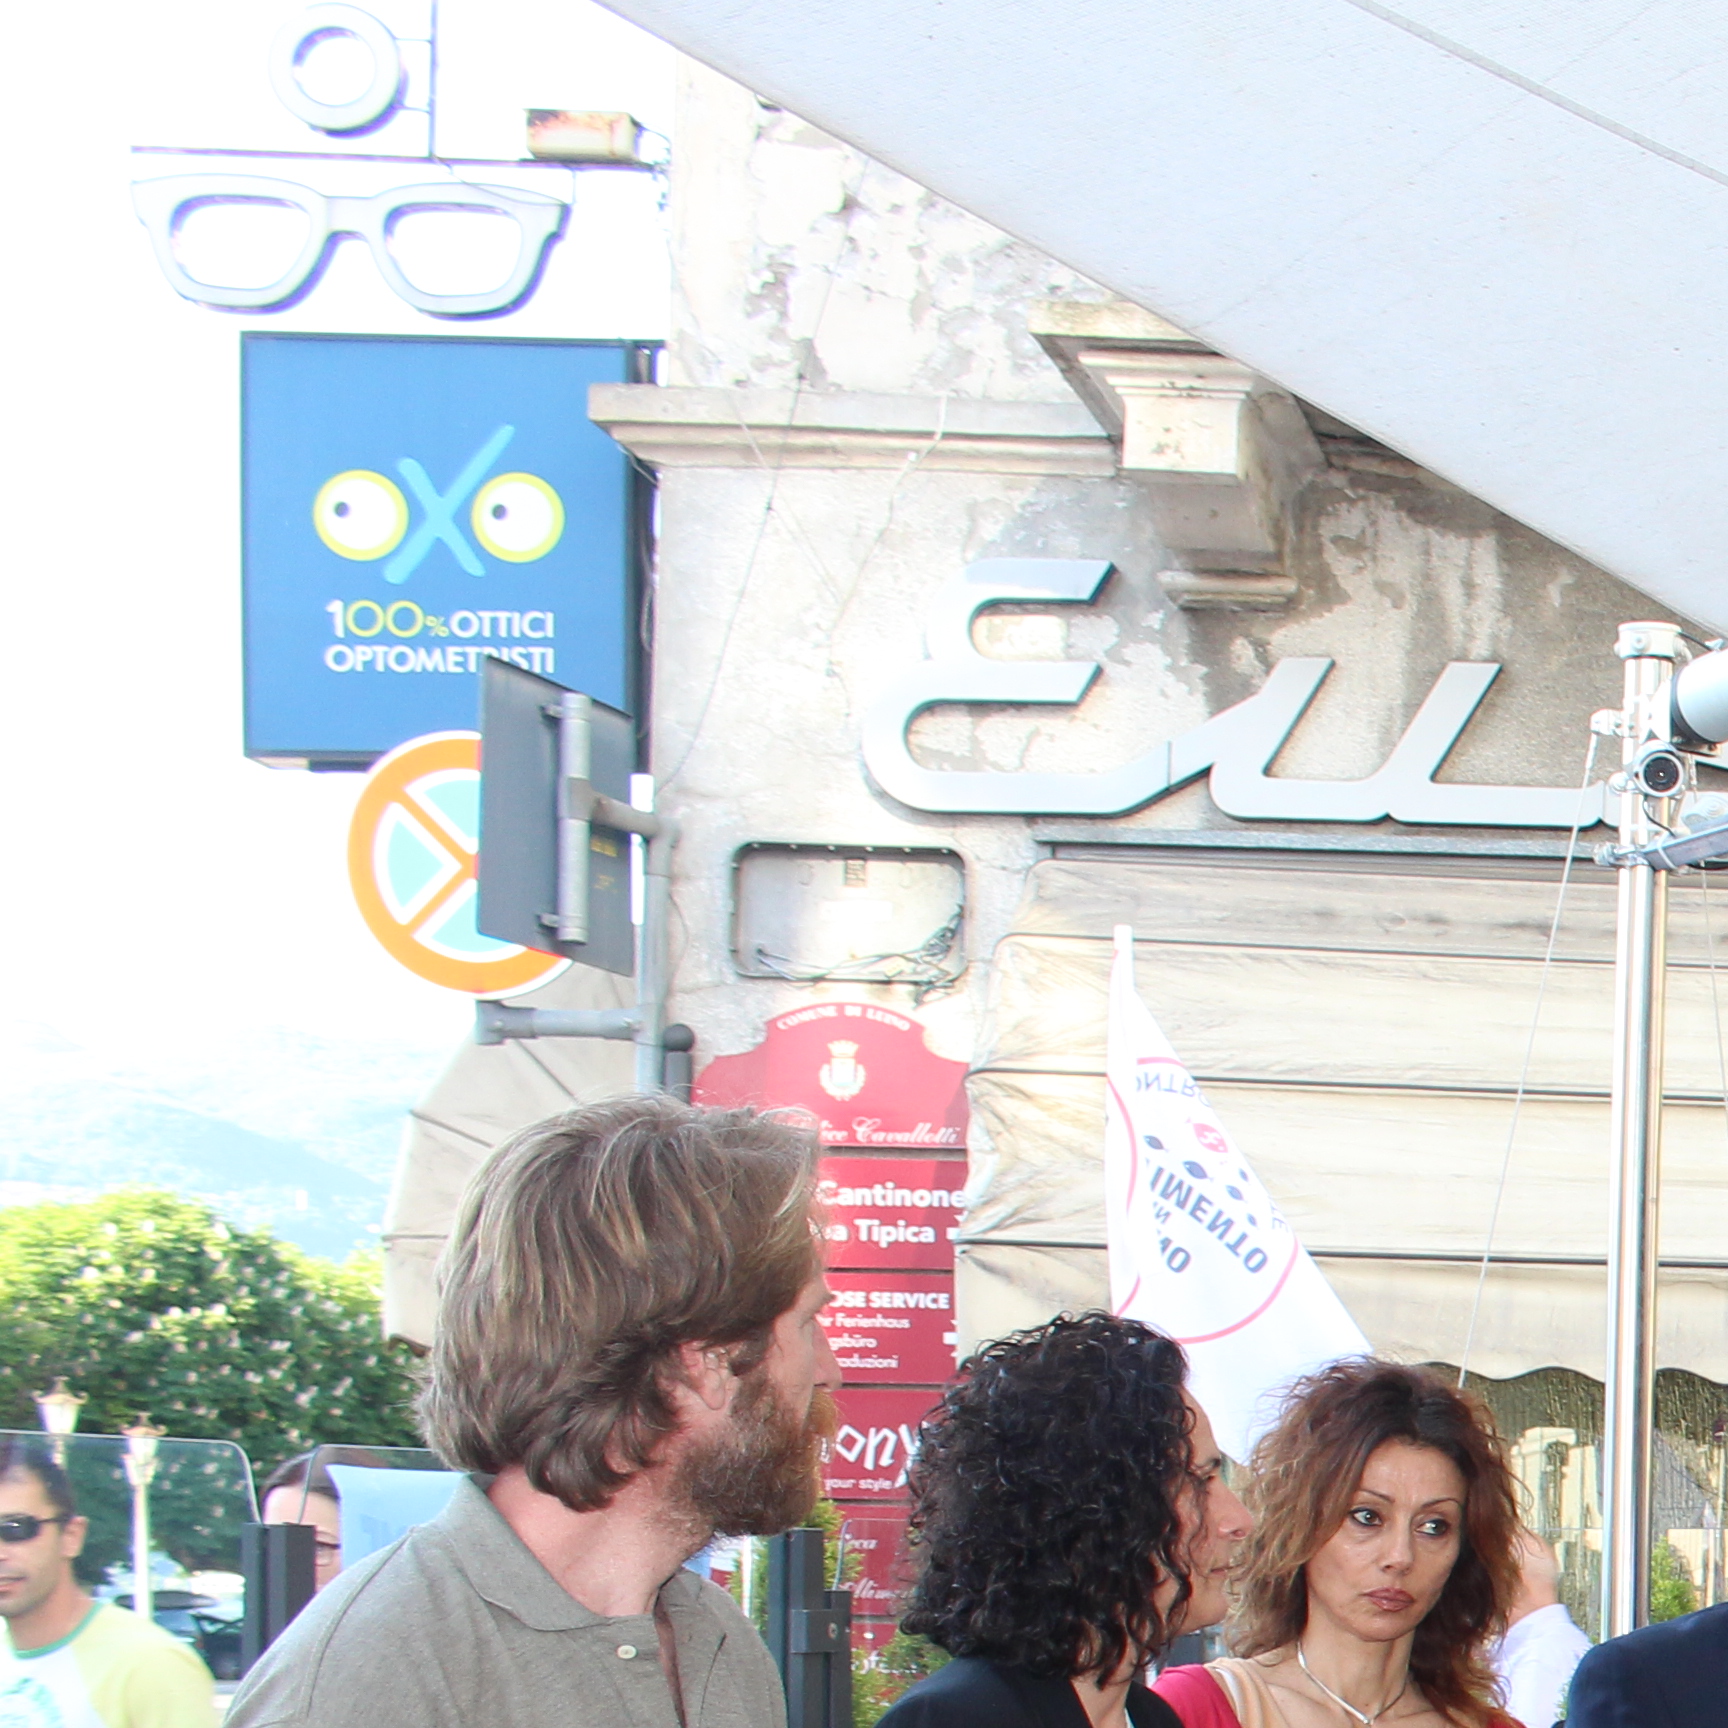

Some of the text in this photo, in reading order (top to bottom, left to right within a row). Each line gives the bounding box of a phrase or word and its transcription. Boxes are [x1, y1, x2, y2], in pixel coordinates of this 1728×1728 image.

[450, 610, 555, 638] OTTICI
[844, 1005, 862, 1017] DI
[853, 1218, 936, 1249] Tipica
[868, 1291, 950, 1310] SERVICE
